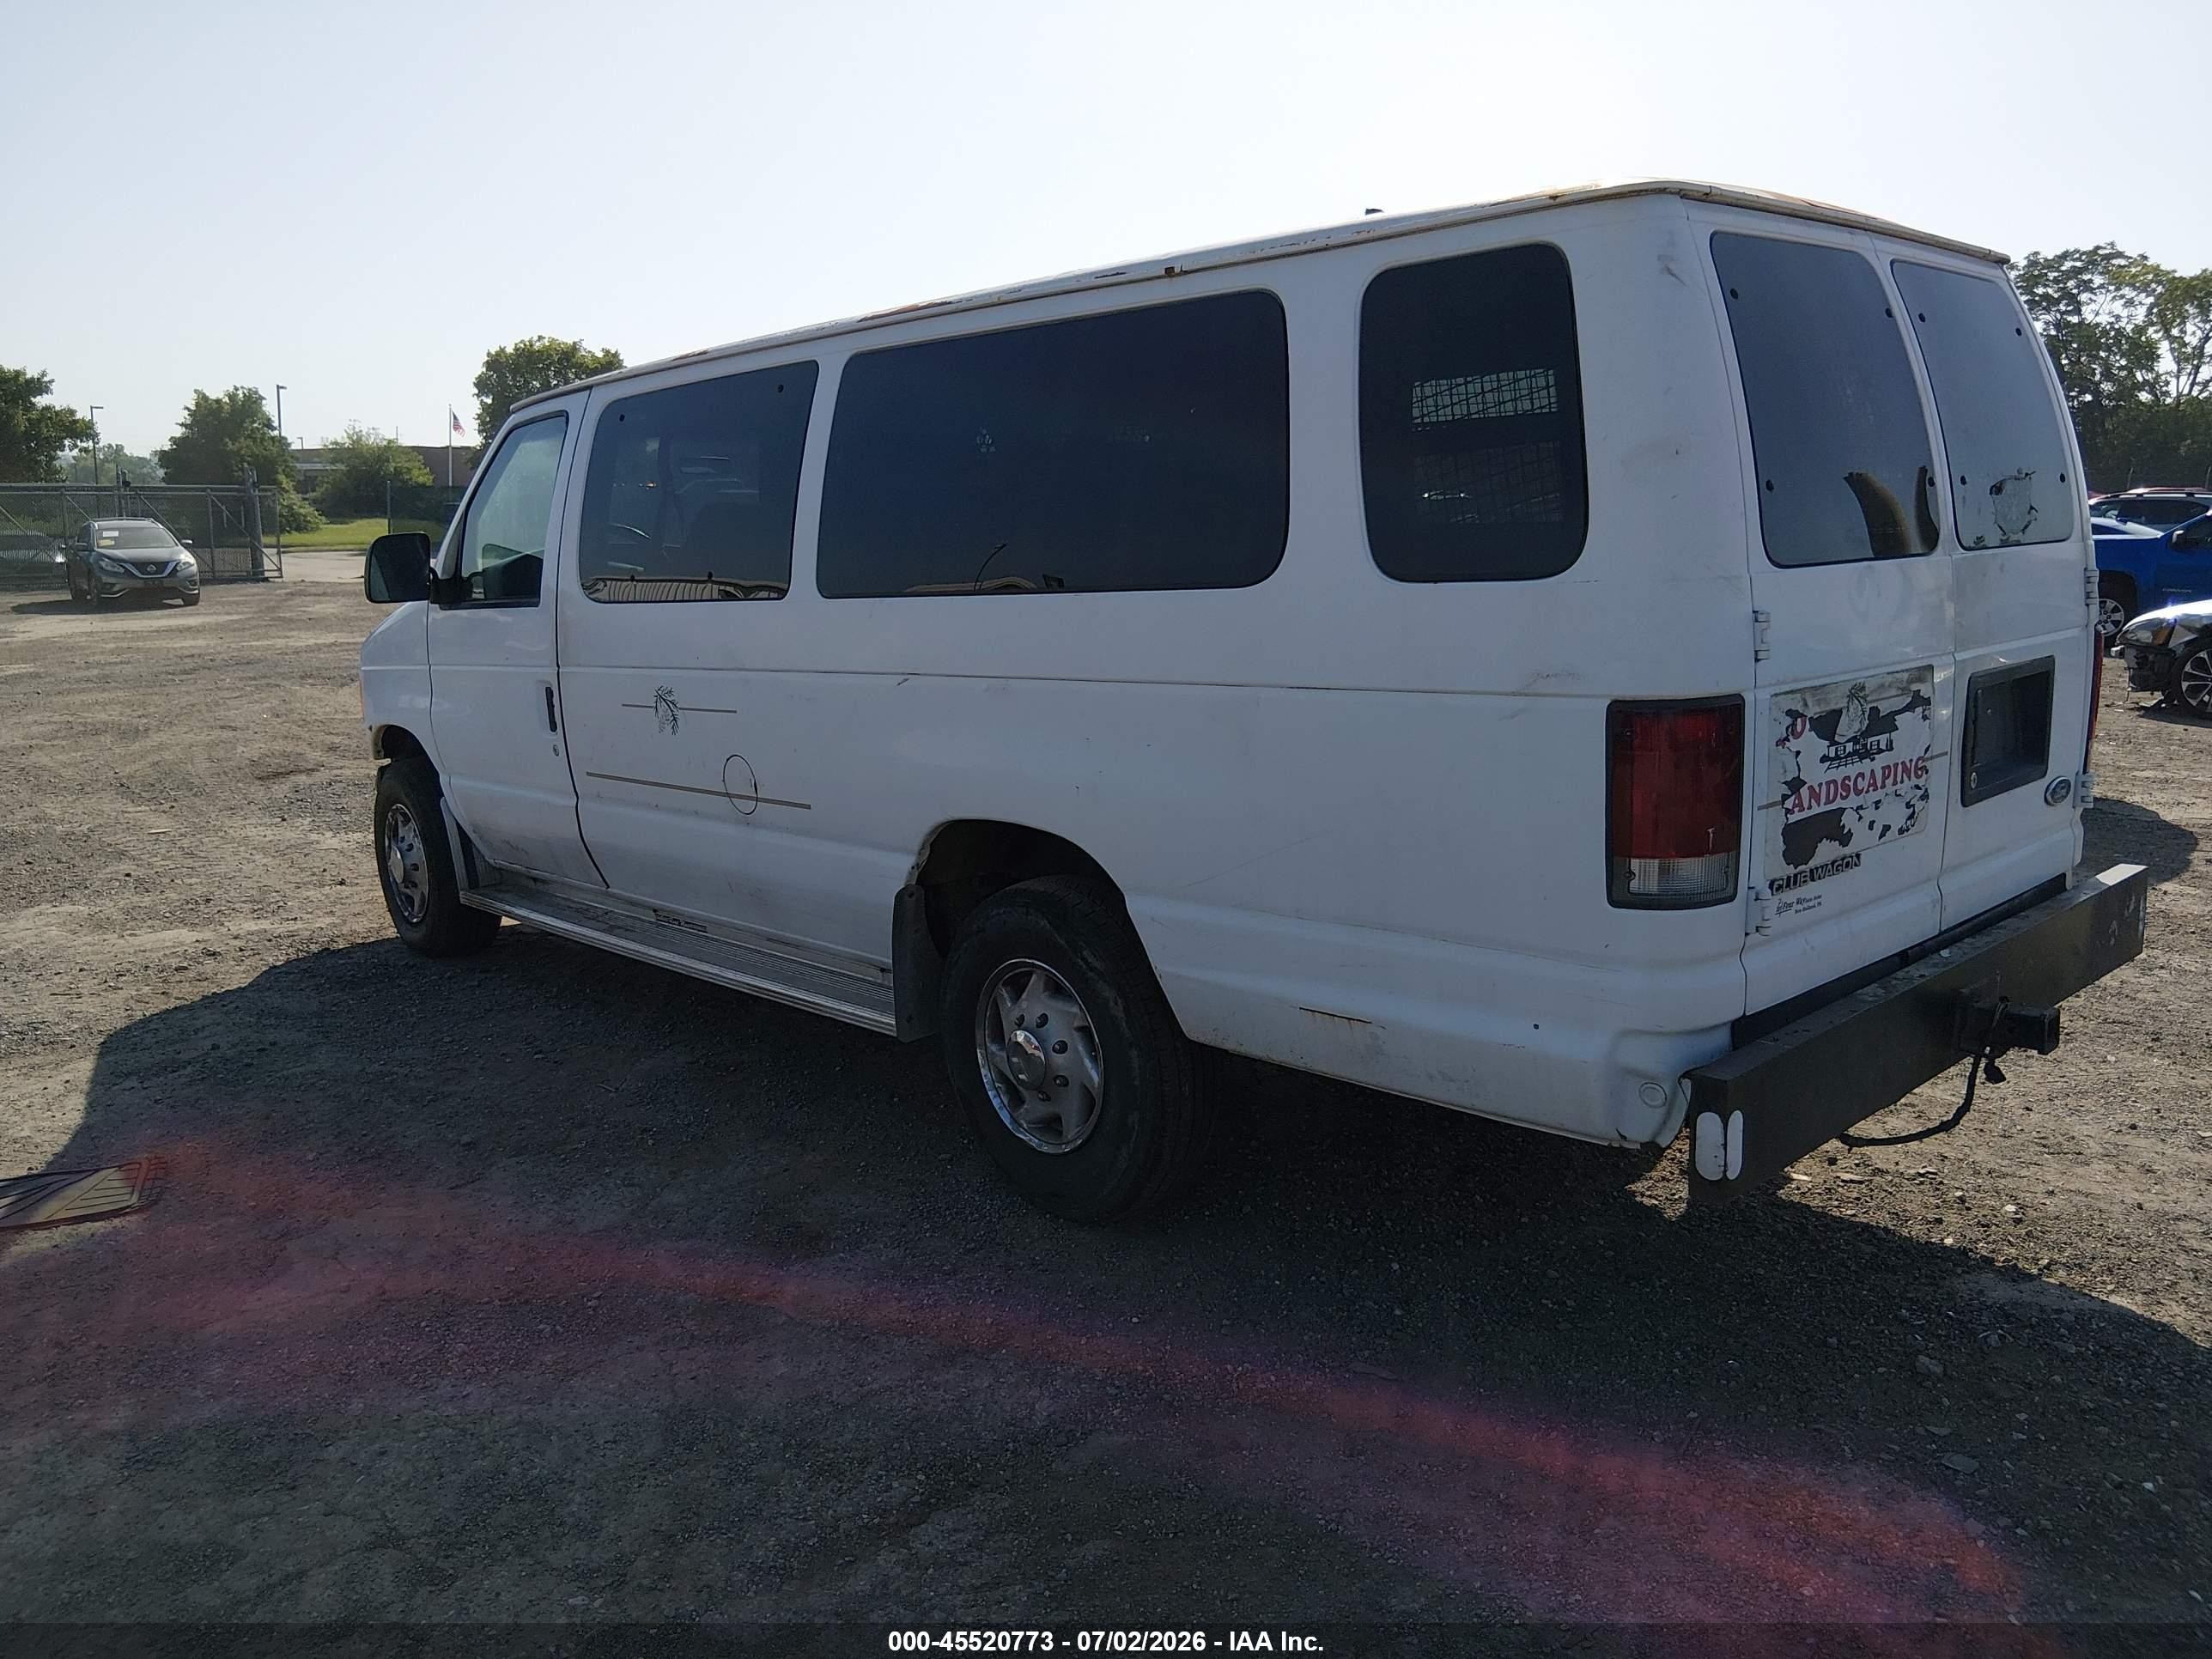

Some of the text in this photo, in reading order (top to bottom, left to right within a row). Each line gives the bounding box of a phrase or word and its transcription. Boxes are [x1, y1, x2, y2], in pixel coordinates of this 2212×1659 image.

[1788, 755, 1925, 816] ANDSCAPING
[1771, 854, 1862, 896] CLUB WAGON
